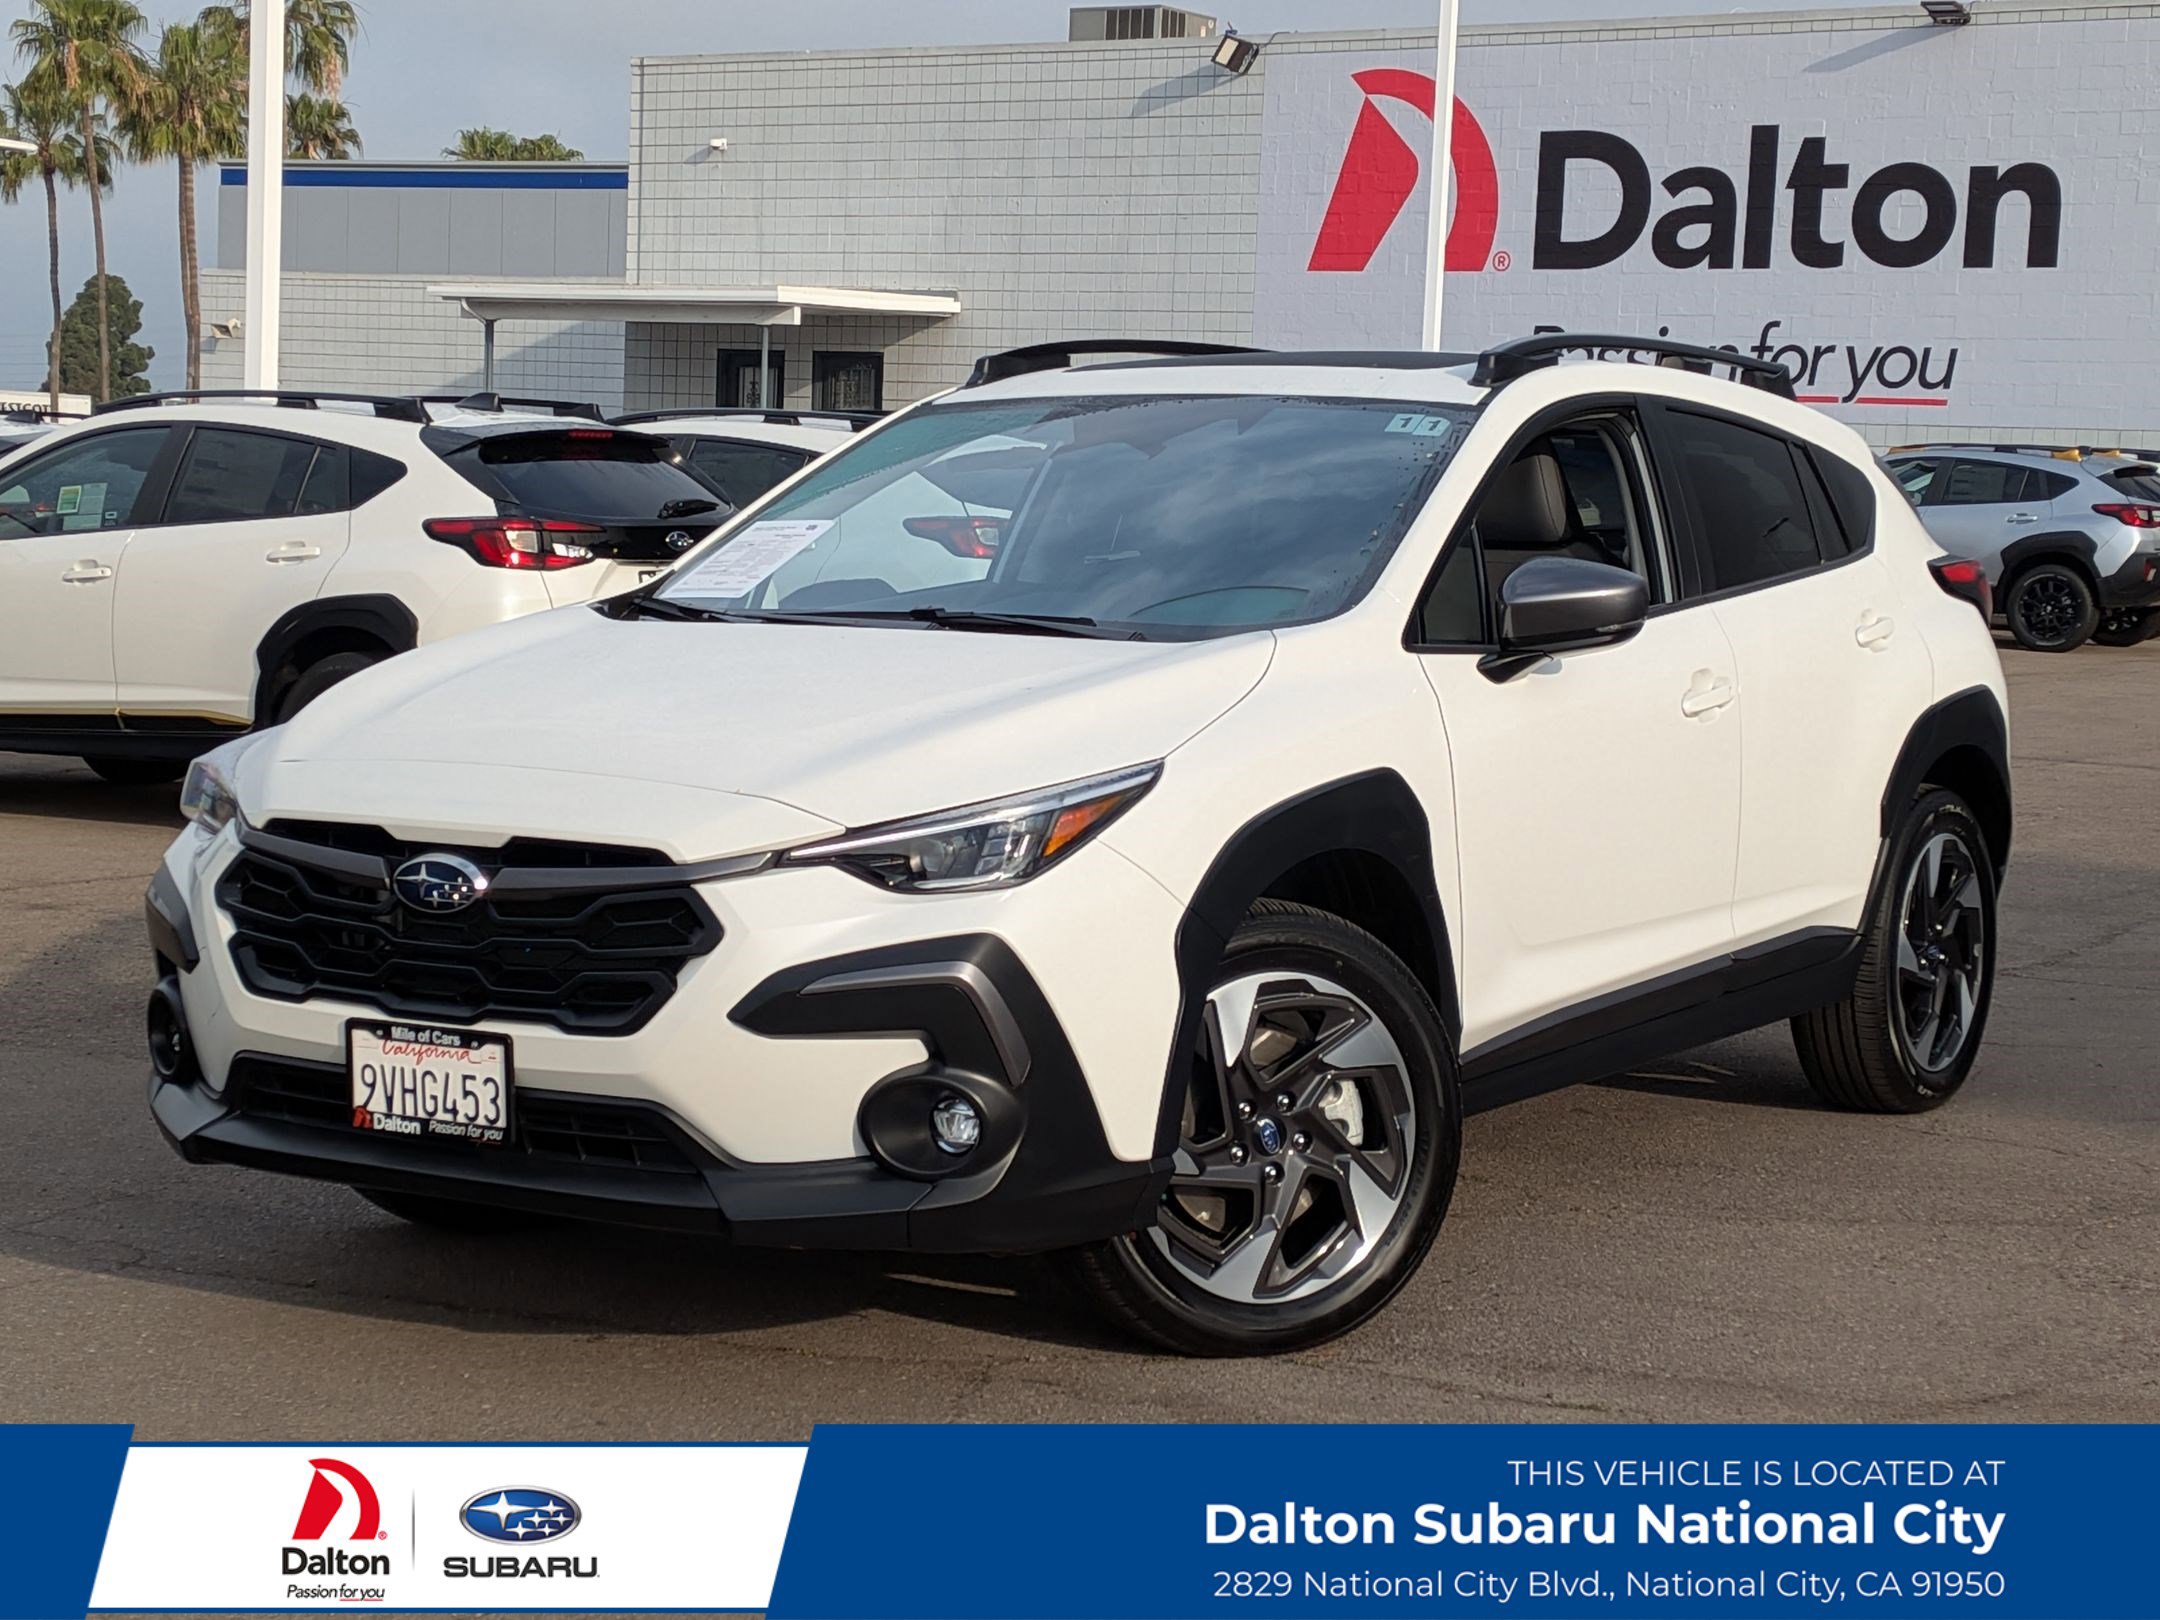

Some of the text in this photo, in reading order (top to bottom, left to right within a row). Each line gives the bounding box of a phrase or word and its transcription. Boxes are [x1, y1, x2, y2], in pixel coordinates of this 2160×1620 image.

[1532, 124, 2062, 271] Dalton
[1842, 345, 1958, 404] you
[391, 1026, 461, 1047] Mile of Cars
[381, 1038, 482, 1066] California
[360, 1063, 501, 1127] 9VHG453
[372, 1112, 422, 1136] Dalton
[428, 1121, 504, 1142] Passion for you
